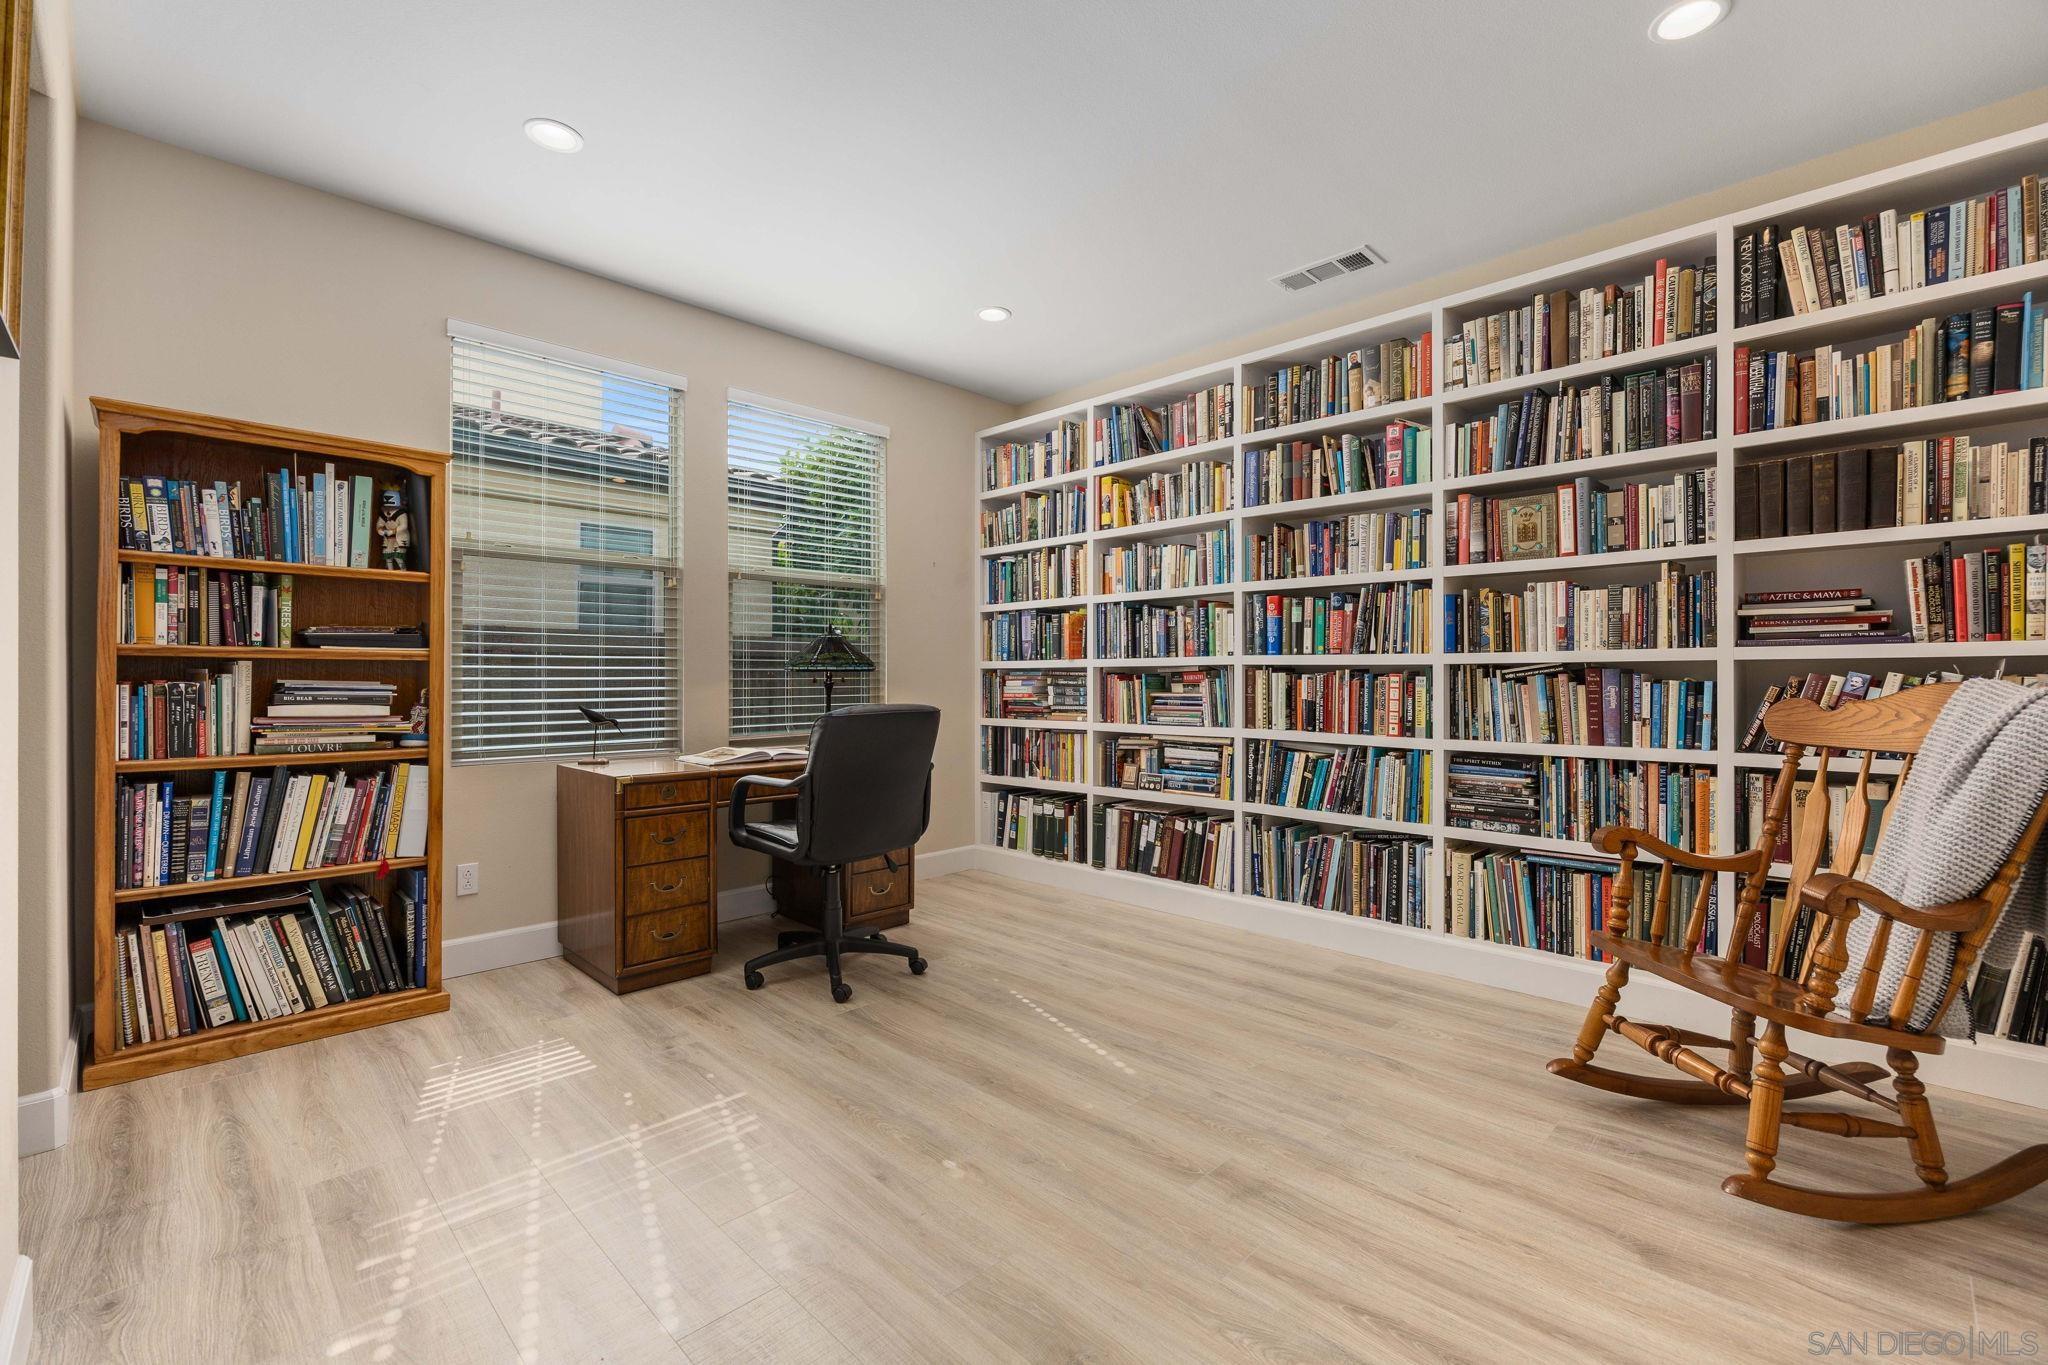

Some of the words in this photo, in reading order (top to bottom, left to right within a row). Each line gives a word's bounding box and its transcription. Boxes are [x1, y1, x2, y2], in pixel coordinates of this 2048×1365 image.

[1740, 238, 1752, 263] NEW
[1741, 263, 1752, 283] YORK
[1667, 276, 1675, 312] CALIFORNIA
[119, 497, 132, 528] BIRDS
[132, 492, 145, 519] BIRDS
[316, 490, 324, 509] BIRD
[156, 505, 169, 537] BIRDS
[220, 510, 231, 538] BIRDS
[315, 510, 324, 539] SONGS
[232, 581, 240, 606] GAUGUIN
[281, 600, 291, 628] TREES
[1759, 701, 1771, 719] STUPID
[1750, 718, 1761, 736] WHITE
[290, 744, 343, 753] LOUVRE
[1743, 735, 1753, 747] MEN
[389, 810, 400, 833] MAPS
[1708, 896, 1716, 921] RUSSIA
[340, 916, 348, 928] Atlas
[344, 933, 356, 952] Human
[350, 951, 362, 971] Anatomy
[1753, 912, 1761, 948] HOLOCAUST
[289, 927, 304, 956] WORLD
[301, 957, 315, 984] HISTORY
[313, 940, 329, 972] VIETNAM
[324, 973, 336, 991] WAR
[195, 953, 214, 995] FRENCH
